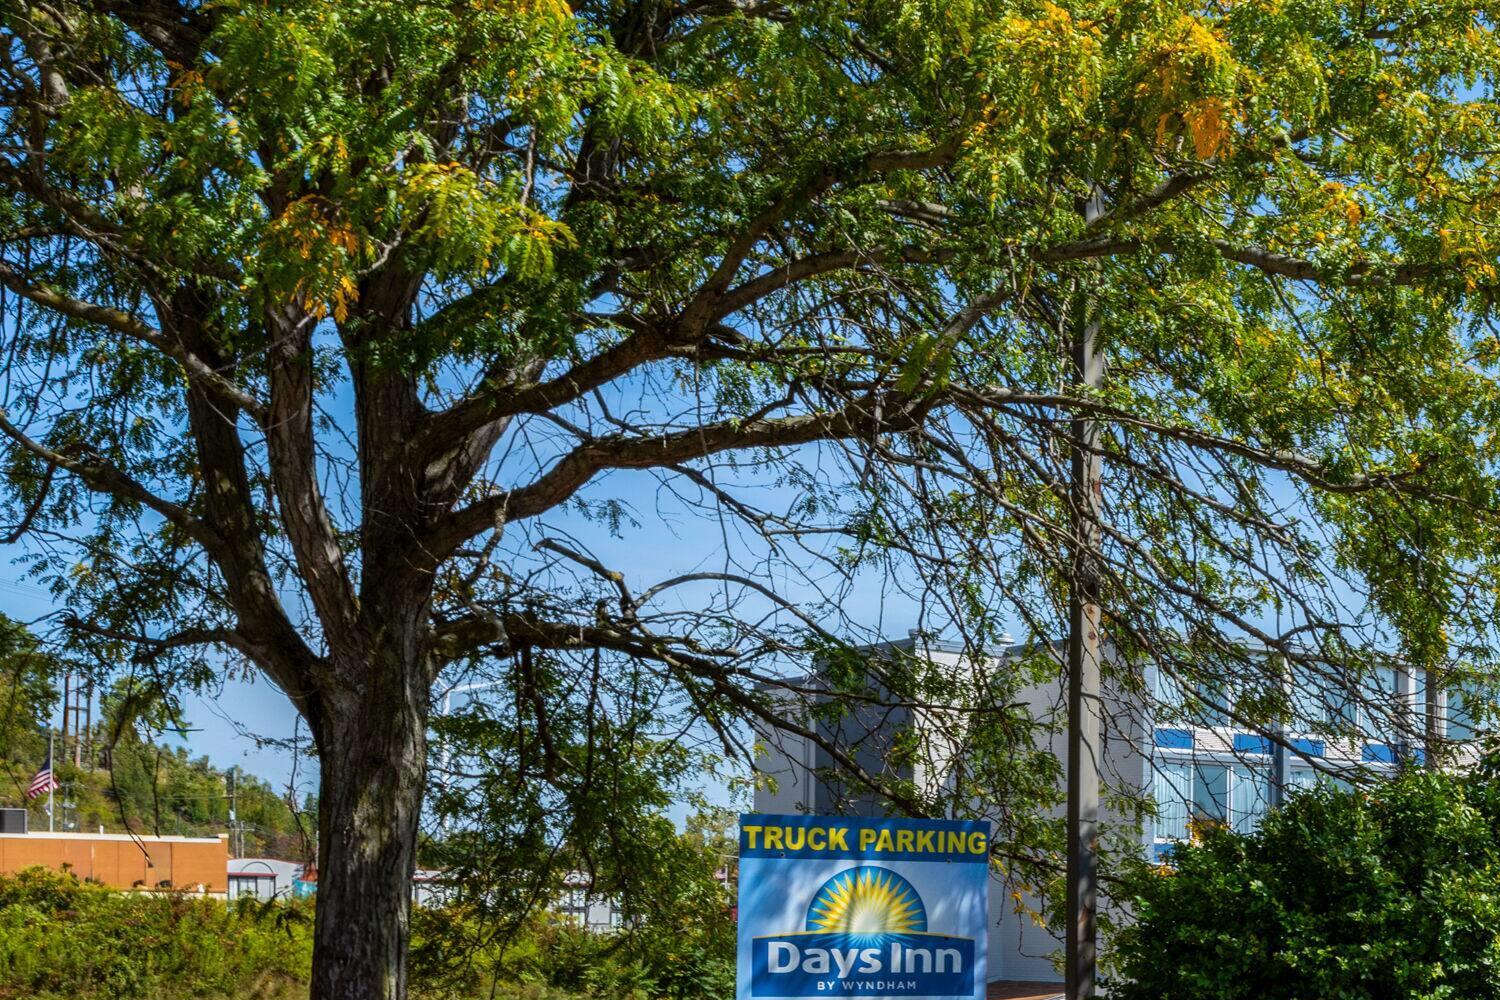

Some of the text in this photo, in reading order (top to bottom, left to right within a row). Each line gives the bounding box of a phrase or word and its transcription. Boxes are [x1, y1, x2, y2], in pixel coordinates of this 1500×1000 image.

[743, 825, 987, 855] TRUCK PARKING
[767, 941, 962, 978] Days Inn
[817, 981, 916, 990] BY WYNDHAM
